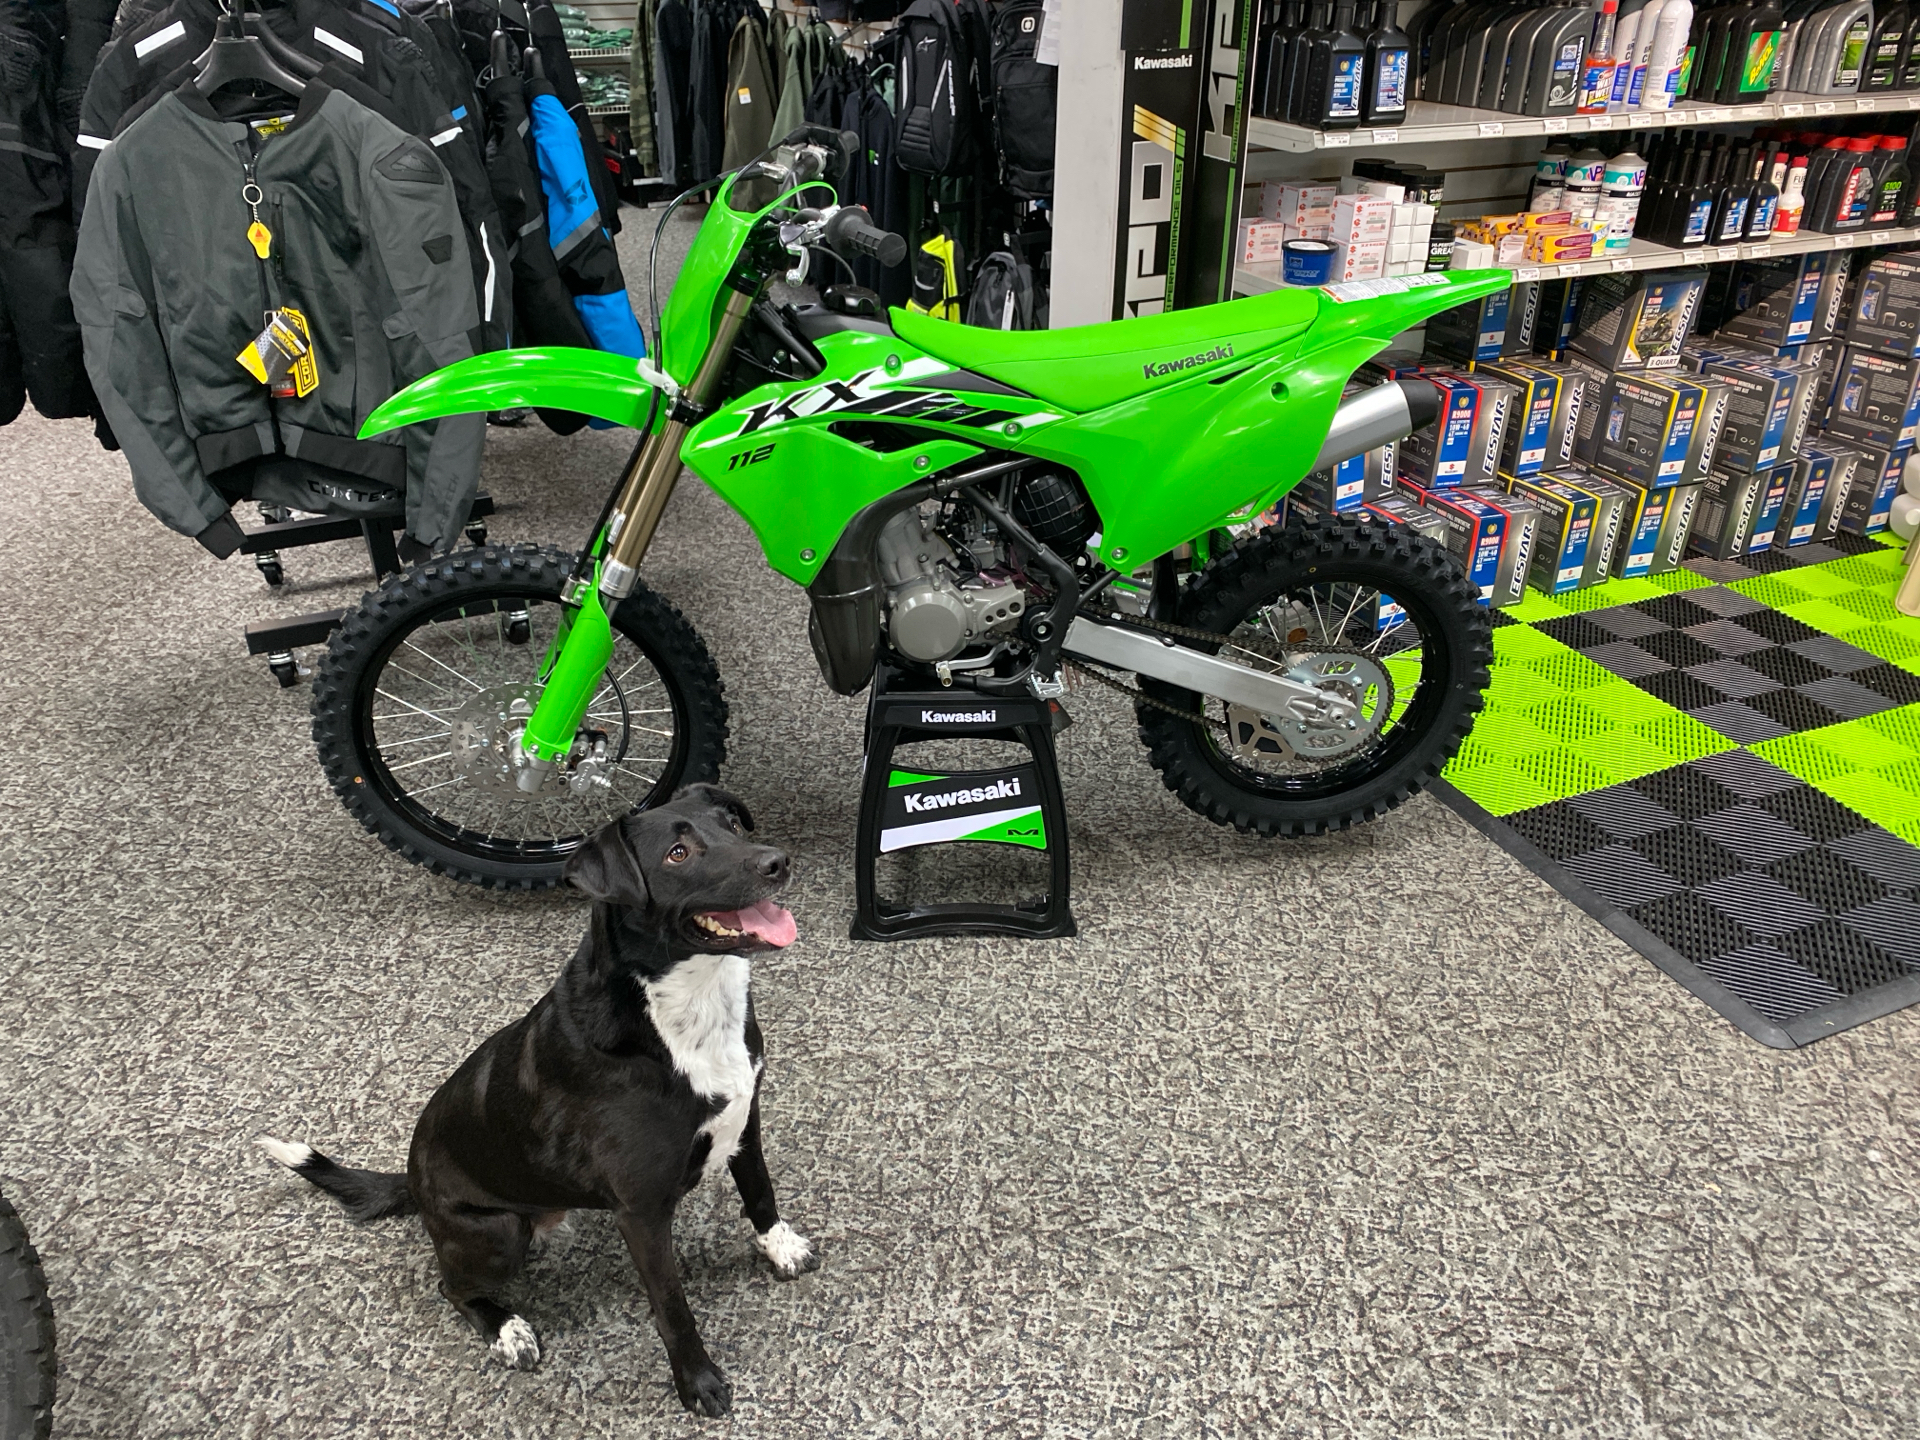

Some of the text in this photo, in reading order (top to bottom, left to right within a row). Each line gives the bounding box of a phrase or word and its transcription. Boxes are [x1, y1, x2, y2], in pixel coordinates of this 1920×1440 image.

[1134, 55, 1193, 70] Kawasaki
[1590, 166, 1603, 181] VP
[1843, 172, 1861, 217] MOTUL
[1165, 163, 1183, 302] PERFORMANCE OILS
[1825, 253, 1852, 332] ECSTAR
[1670, 286, 1700, 354] ECSTAR
[1143, 343, 1234, 379] Kawasaki
[1655, 358, 1678, 366] QUART
[738, 370, 878, 437] KX
[1452, 409, 1472, 419] R9000
[1531, 413, 1550, 421] 10W-40
[1533, 399, 1552, 409] R7000
[1676, 409, 1695, 420] R7000
[1790, 376, 1819, 454] ECSTAR
[1449, 423, 1470, 431] 10W-40
[1482, 393, 1509, 475] ECSTAR
[1560, 381, 1585, 461] ECSTAR
[1673, 423, 1692, 431] 10W-40
[1698, 392, 1729, 474] ECSTAR
[727, 443, 777, 472] 112
[1381, 441, 1394, 488] ECST
[1645, 506, 1664, 515] R7000
[1828, 461, 1858, 533] ECSTAR
[1573, 518, 1590, 529] R7000
[1641, 519, 1660, 527] 10W-40
[1667, 490, 1698, 565] ECSTAR
[1731, 479, 1760, 553] ECSTAR
[1481, 536, 1500, 546] R9000
[1570, 531, 1588, 540] 10W-40
[1597, 500, 1624, 577] ECSTAR
[1478, 550, 1498, 558] 10W-40
[1510, 518, 1536, 597] ECSTAR
[921, 710, 996, 723] Kawasaki
[903, 778, 1022, 813] Kawasaki
